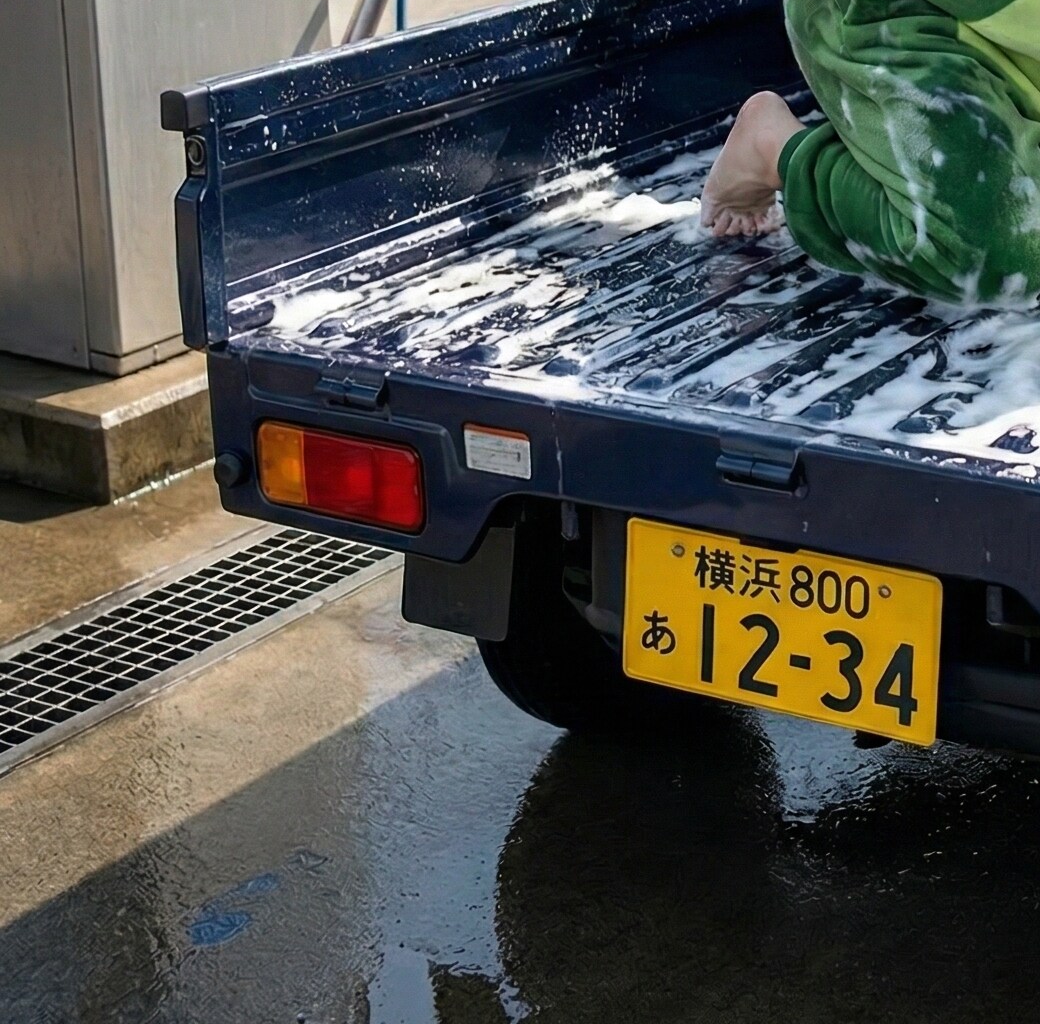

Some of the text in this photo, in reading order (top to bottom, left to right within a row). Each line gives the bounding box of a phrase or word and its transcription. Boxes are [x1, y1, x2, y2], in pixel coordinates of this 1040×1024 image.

[694, 545, 870, 620] 横浜 800
[641, 602, 919, 728] あ 12-34
